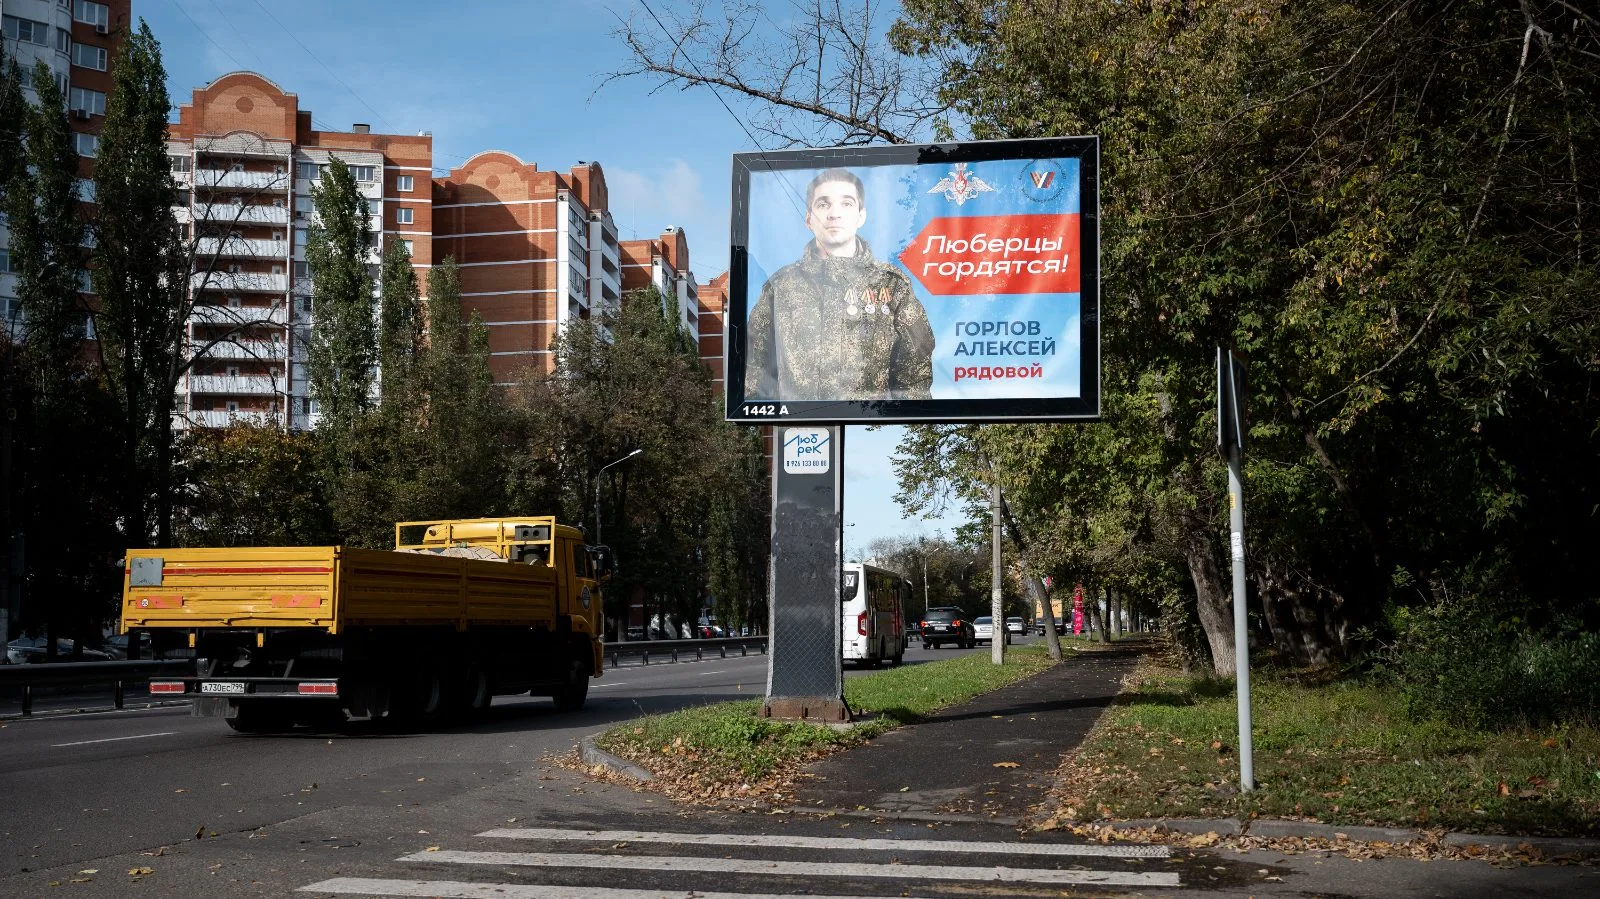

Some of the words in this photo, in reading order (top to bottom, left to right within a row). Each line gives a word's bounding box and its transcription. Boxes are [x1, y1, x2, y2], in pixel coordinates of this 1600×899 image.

[922, 233, 1062, 258] Люберцы
[922, 254, 1069, 281] гордятся!
[955, 320, 1041, 337] ГОРЛОВ
[954, 336, 1056, 356] АЛЕКСЕЙ
[954, 362, 1043, 382] рядовой
[743, 405, 775, 416] 1442
[779, 405, 789, 415] А
